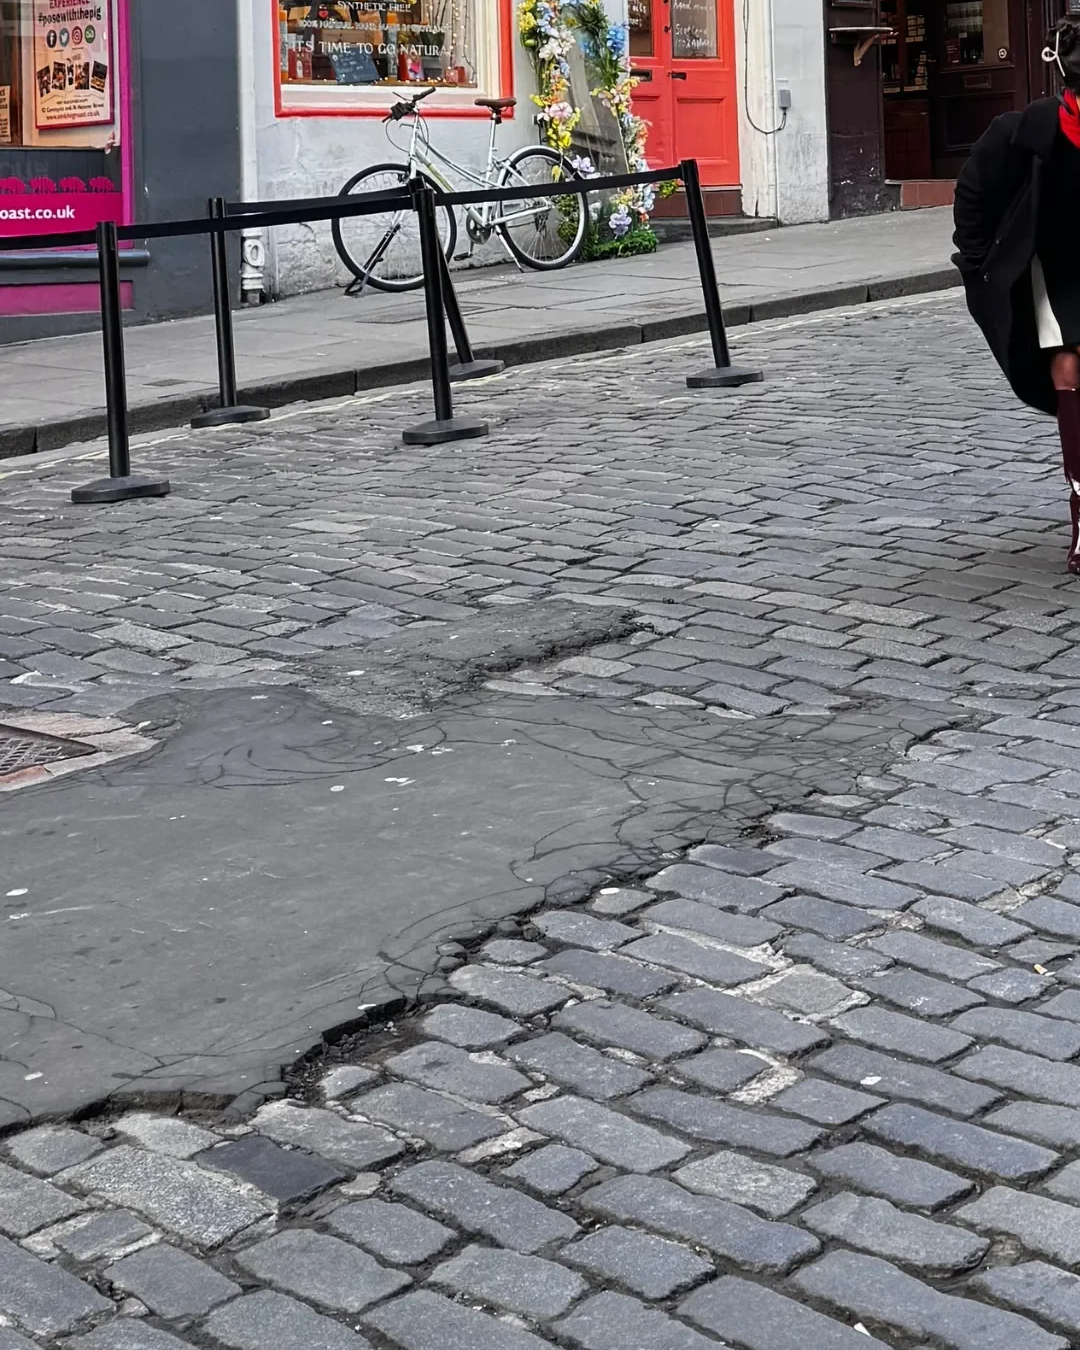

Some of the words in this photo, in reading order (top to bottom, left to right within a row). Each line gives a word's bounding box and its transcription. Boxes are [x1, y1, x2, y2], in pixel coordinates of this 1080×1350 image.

[337, 0, 387, 13] SYNTHETIC
[38, 6, 102, 26] #posewiththepig
[319, 41, 351, 54] TIME
[355, 43, 374, 55] TO
[377, 43, 396, 55] GO
[399, 44, 450, 57] NATURA
